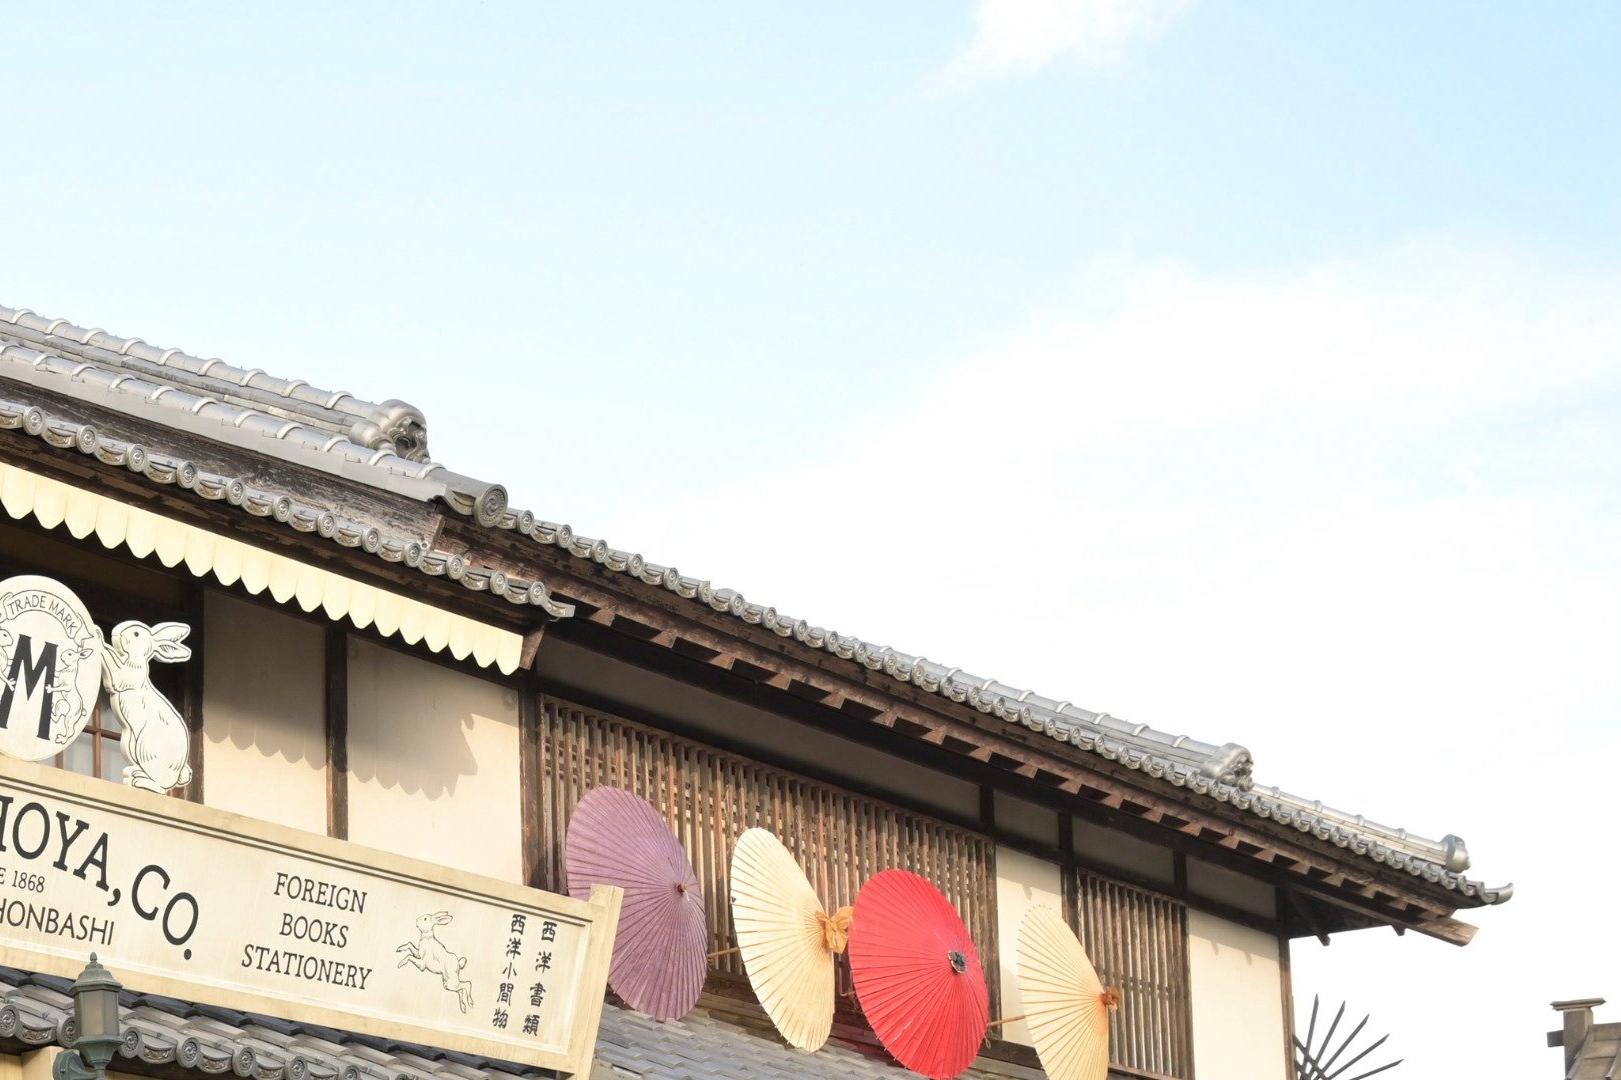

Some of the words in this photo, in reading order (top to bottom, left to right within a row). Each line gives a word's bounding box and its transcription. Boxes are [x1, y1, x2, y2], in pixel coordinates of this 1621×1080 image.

[7, 594, 47, 615] TRADE
[48, 598, 78, 635] MARK
[10, 869, 46, 894] 1868
[273, 872, 368, 915] FOREIGN
[279, 912, 349, 949] BOOKS
[241, 943, 373, 990] STATIONERY
[492, 913, 527, 1030] 西洋小間物
